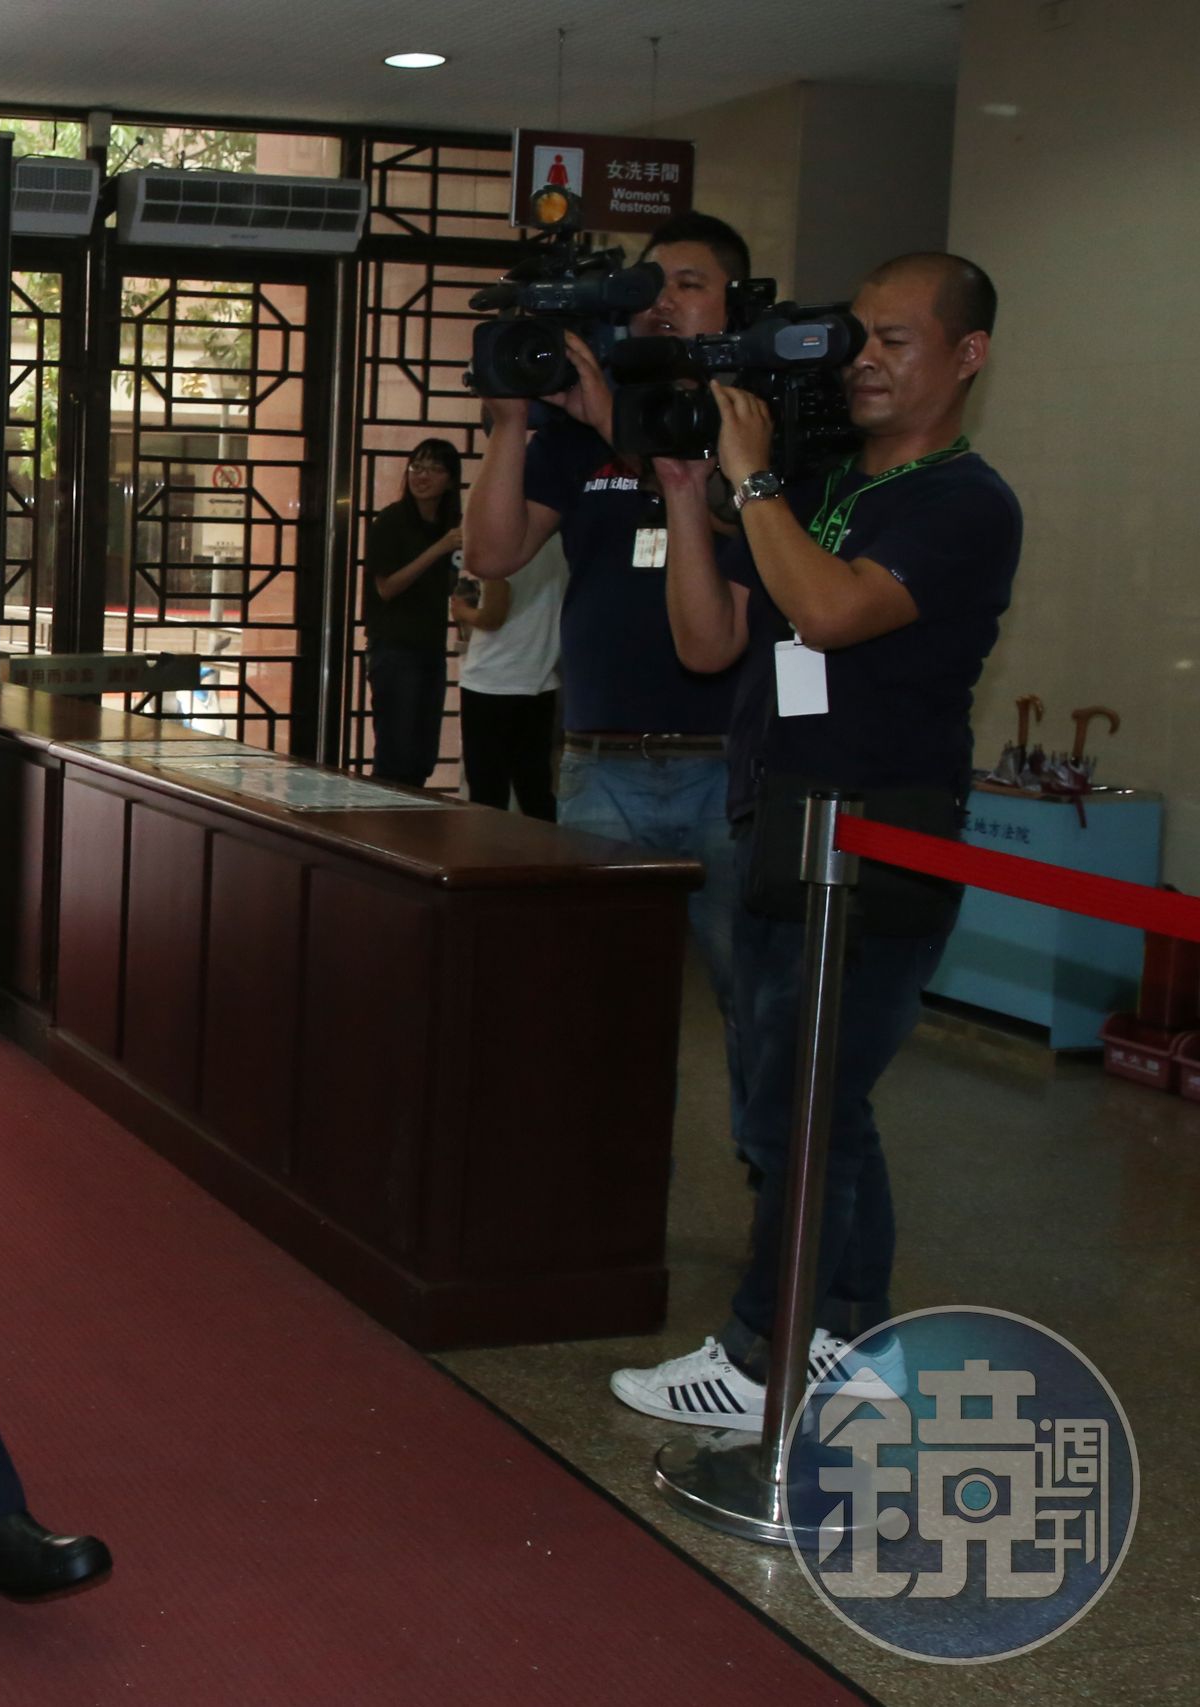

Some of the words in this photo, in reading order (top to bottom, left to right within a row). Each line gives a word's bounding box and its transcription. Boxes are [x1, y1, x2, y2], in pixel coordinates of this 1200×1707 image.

[606, 160, 680, 183] 女洗手間
[612, 188, 671, 203] Women's
[609, 199, 672, 215] Restroom
[965, 818, 1030, 844] 地方法院
